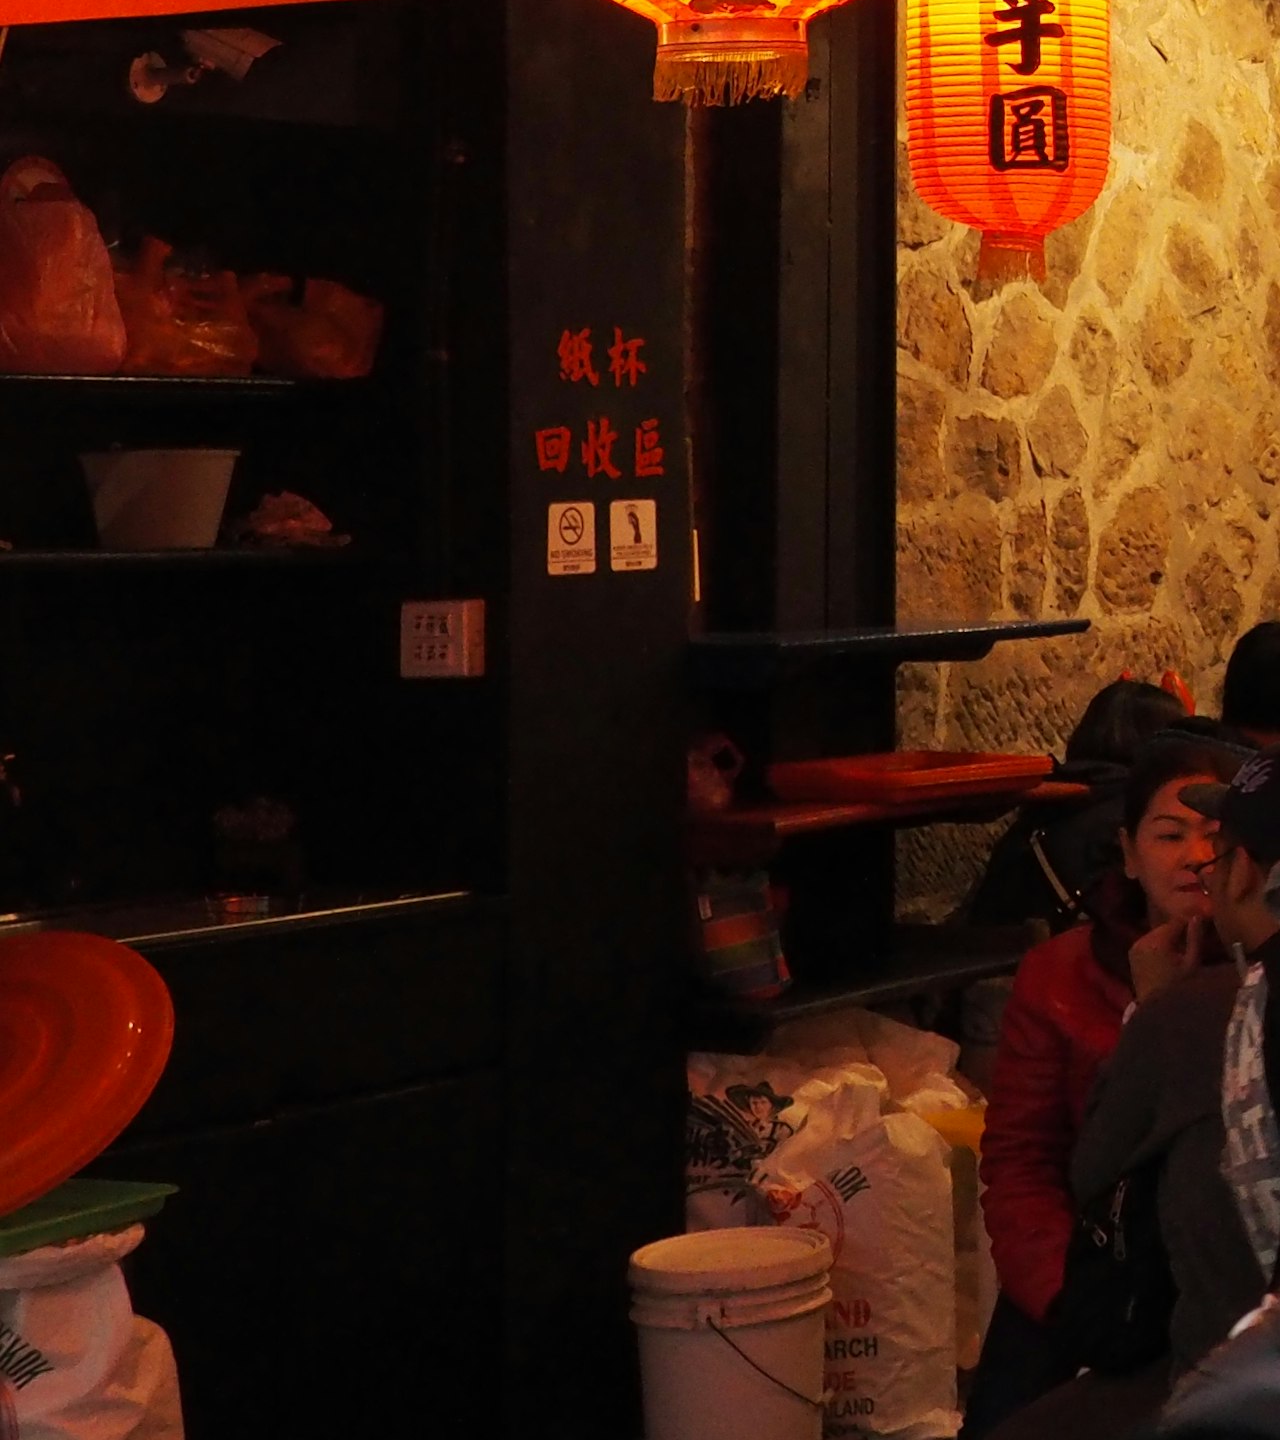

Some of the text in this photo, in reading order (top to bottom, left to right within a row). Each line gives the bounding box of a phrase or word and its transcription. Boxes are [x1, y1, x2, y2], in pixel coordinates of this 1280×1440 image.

[557, 326, 647, 386] 紙杯
[535, 417, 664, 479] 回收區
